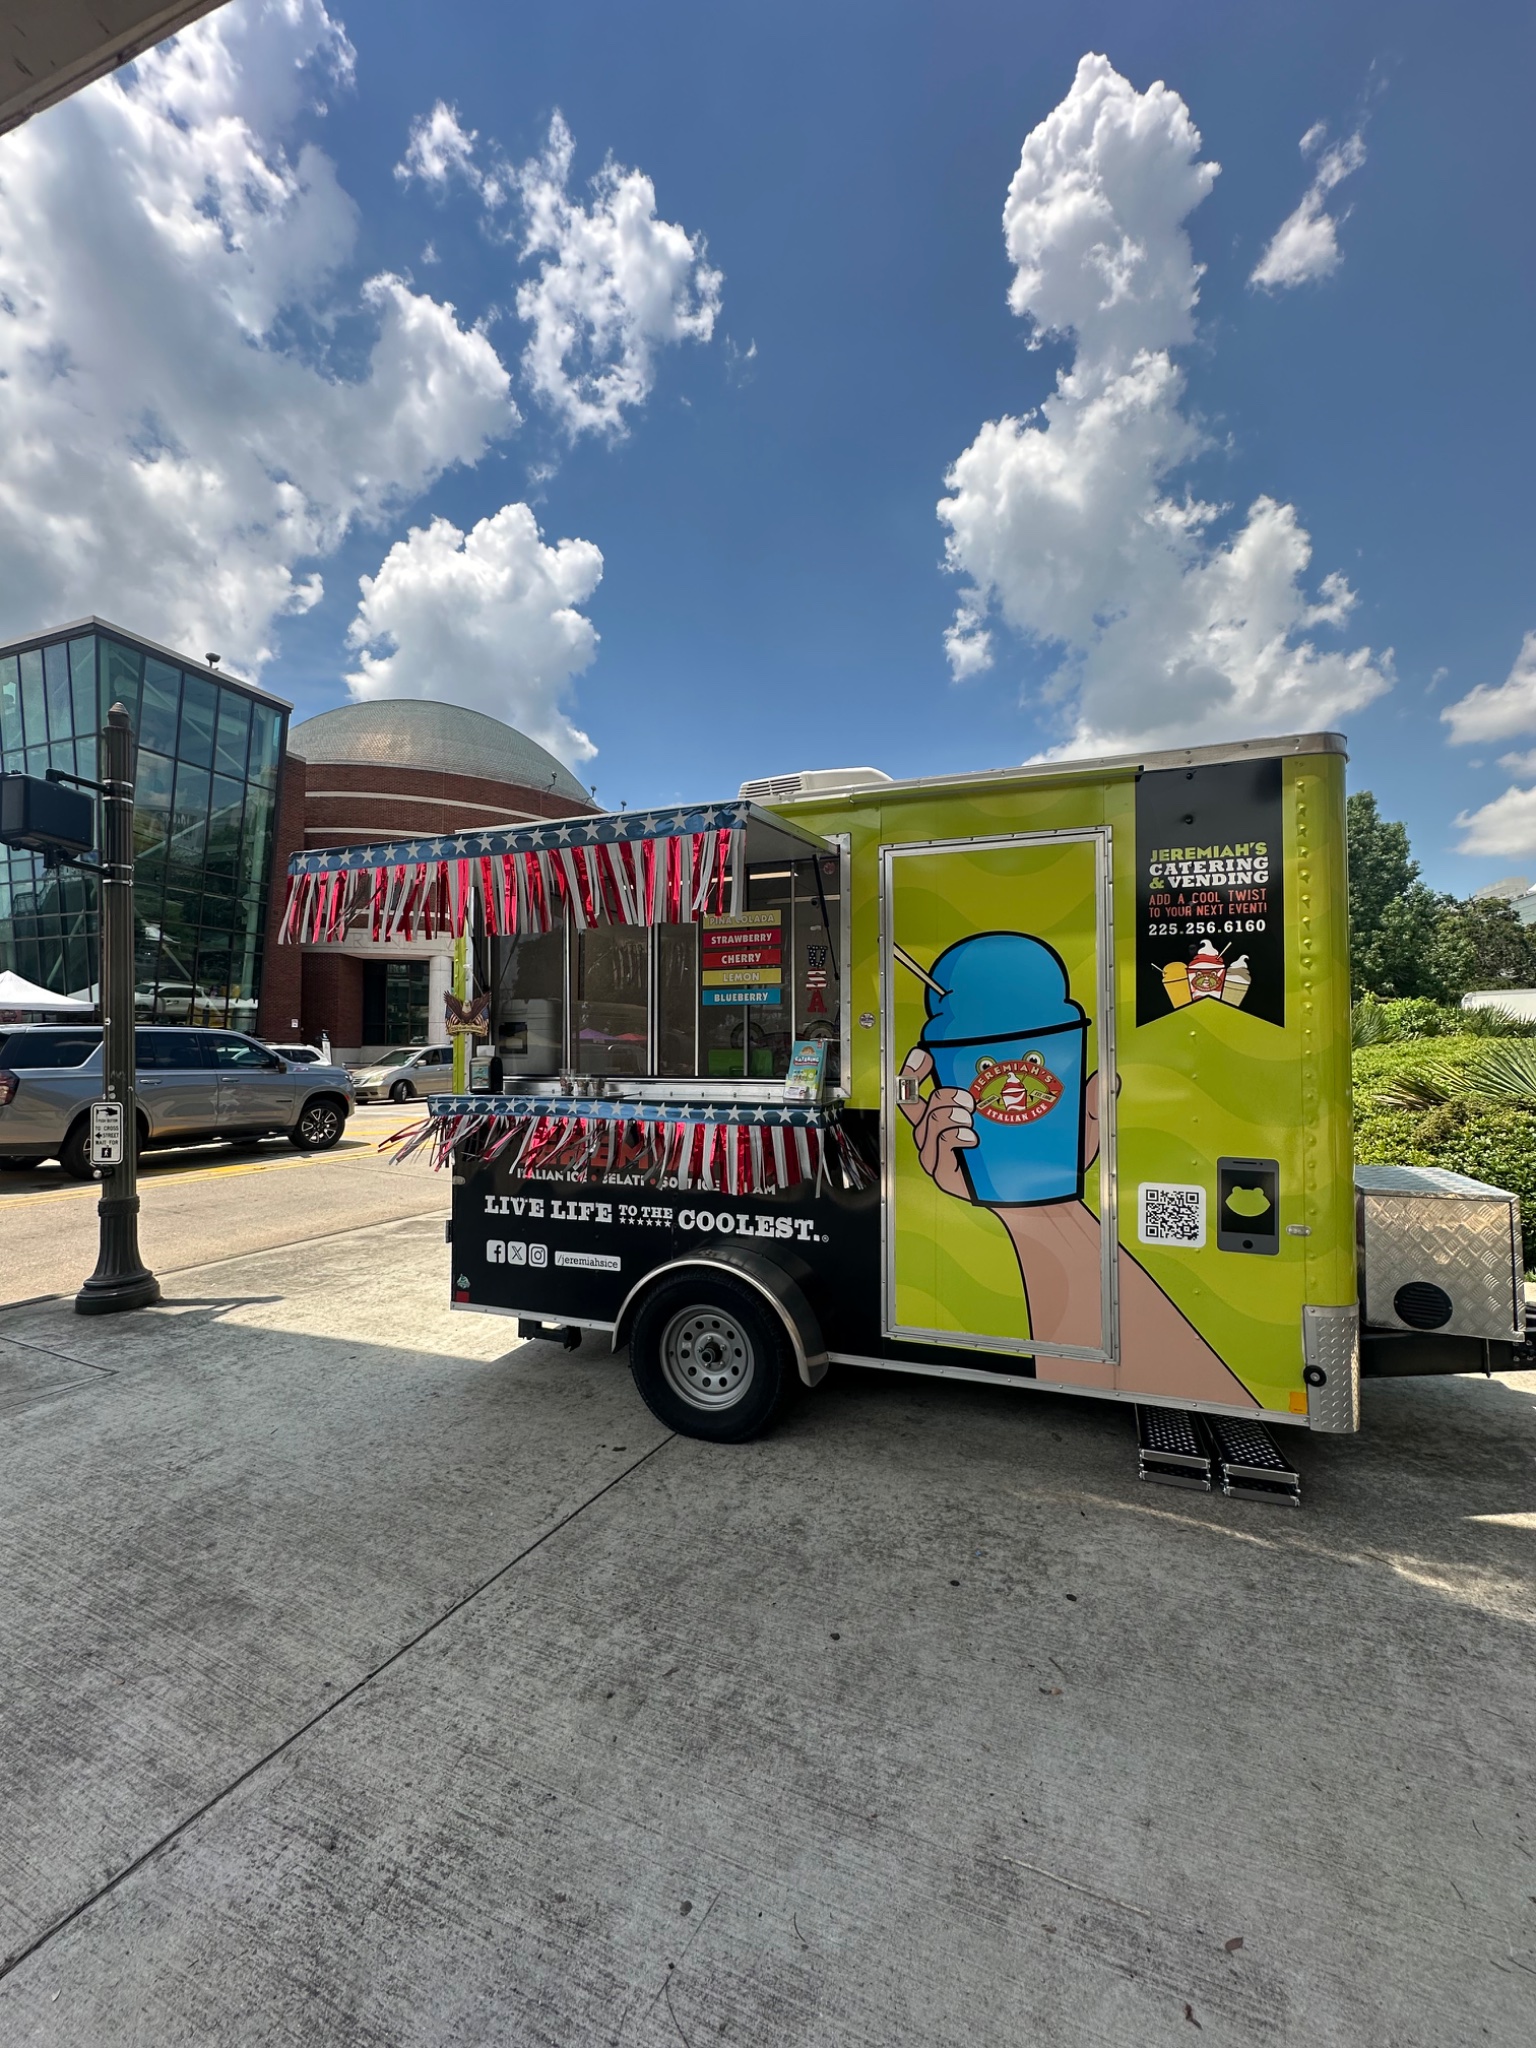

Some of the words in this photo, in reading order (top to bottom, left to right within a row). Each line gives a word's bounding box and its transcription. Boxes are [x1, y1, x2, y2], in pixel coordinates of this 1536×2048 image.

[1150, 842, 1267, 862] JEREMIAH'S
[1149, 857, 1269, 876] CATERING
[1149, 877, 1165, 889] &
[1167, 870, 1269, 888] VENDING
[1149, 893, 1171, 906] ADD
[1177, 893, 1185, 904] A
[1191, 891, 1220, 903] COOL
[1228, 888, 1267, 901] TWIST
[1149, 907, 1161, 918] TO
[1166, 906, 1192, 917] YOUR
[1196, 904, 1224, 916] NEXT
[1228, 902, 1267, 915] EVENT!
[1149, 919, 1266, 936] 225.256.6160
[711, 933, 772, 945] STRAWBERRY
[721, 953, 762, 964] CHERRY
[723, 972, 760, 982] LEMON
[714, 992, 769, 1002] BLUEBERRY
[974, 1063, 1053, 1091] JEREMIAH'S
[986, 1109, 1029, 1122] ITALIAN
[1032, 1103, 1048, 1117] ICE
[484, 1195, 545, 1218] LIVE
[551, 1200, 612, 1223] LIFE
[619, 1204, 638, 1216] TO
[641, 1206, 673, 1219] THE
[557, 1254, 618, 1269] /jeremiahsice
